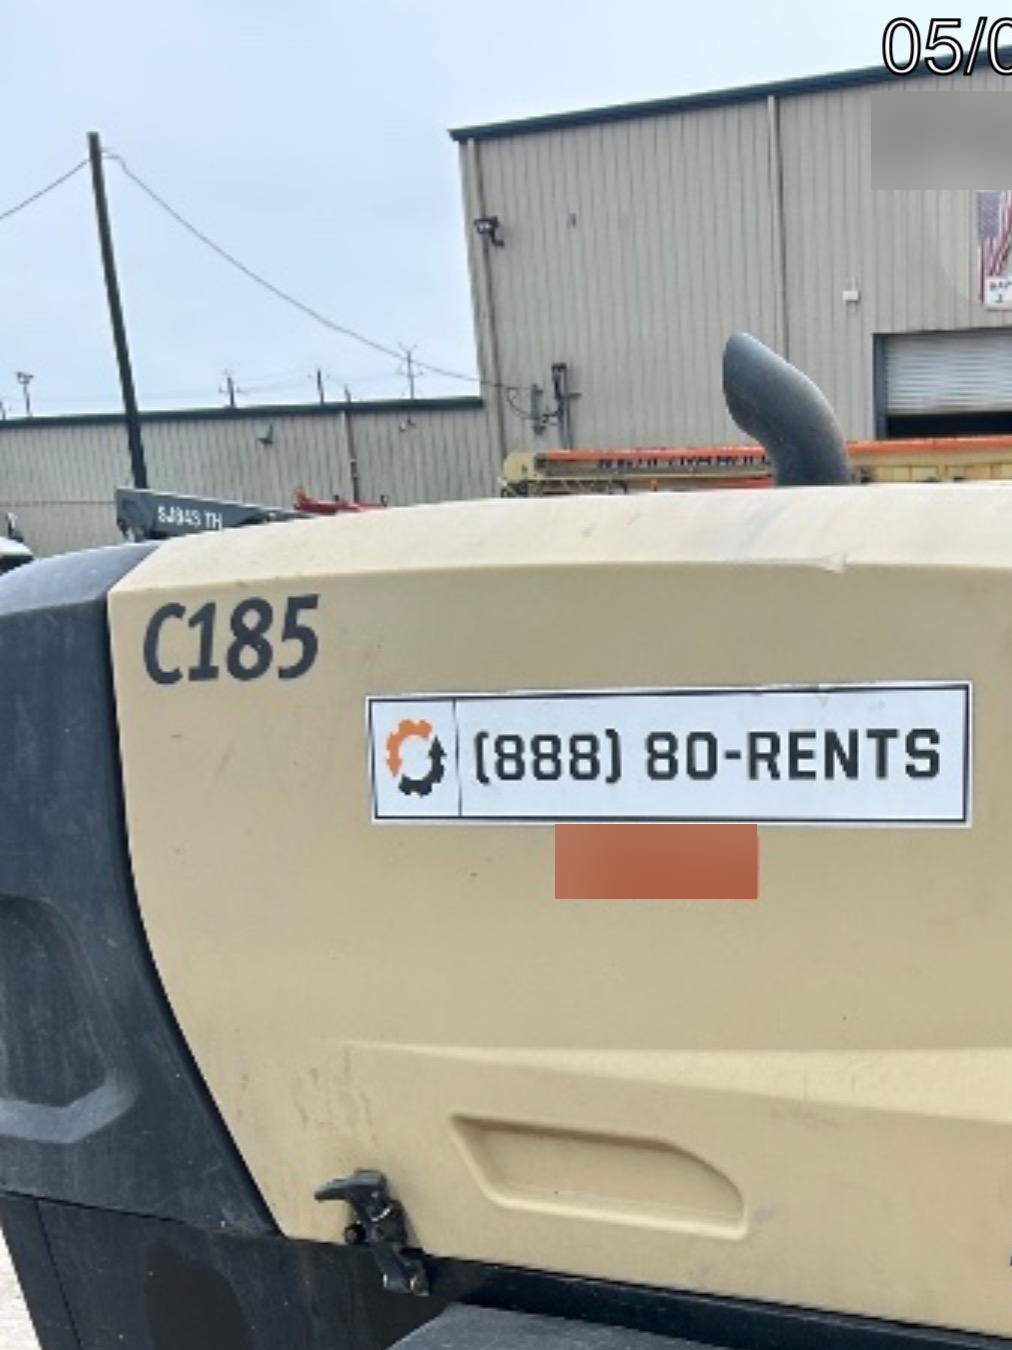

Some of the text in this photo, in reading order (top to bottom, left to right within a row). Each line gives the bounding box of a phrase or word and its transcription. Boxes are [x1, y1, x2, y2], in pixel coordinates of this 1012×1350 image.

[204, 511, 223, 530] TH
[144, 594, 320, 685] C185
[474, 727, 942, 784] (888) 80-RENTS
